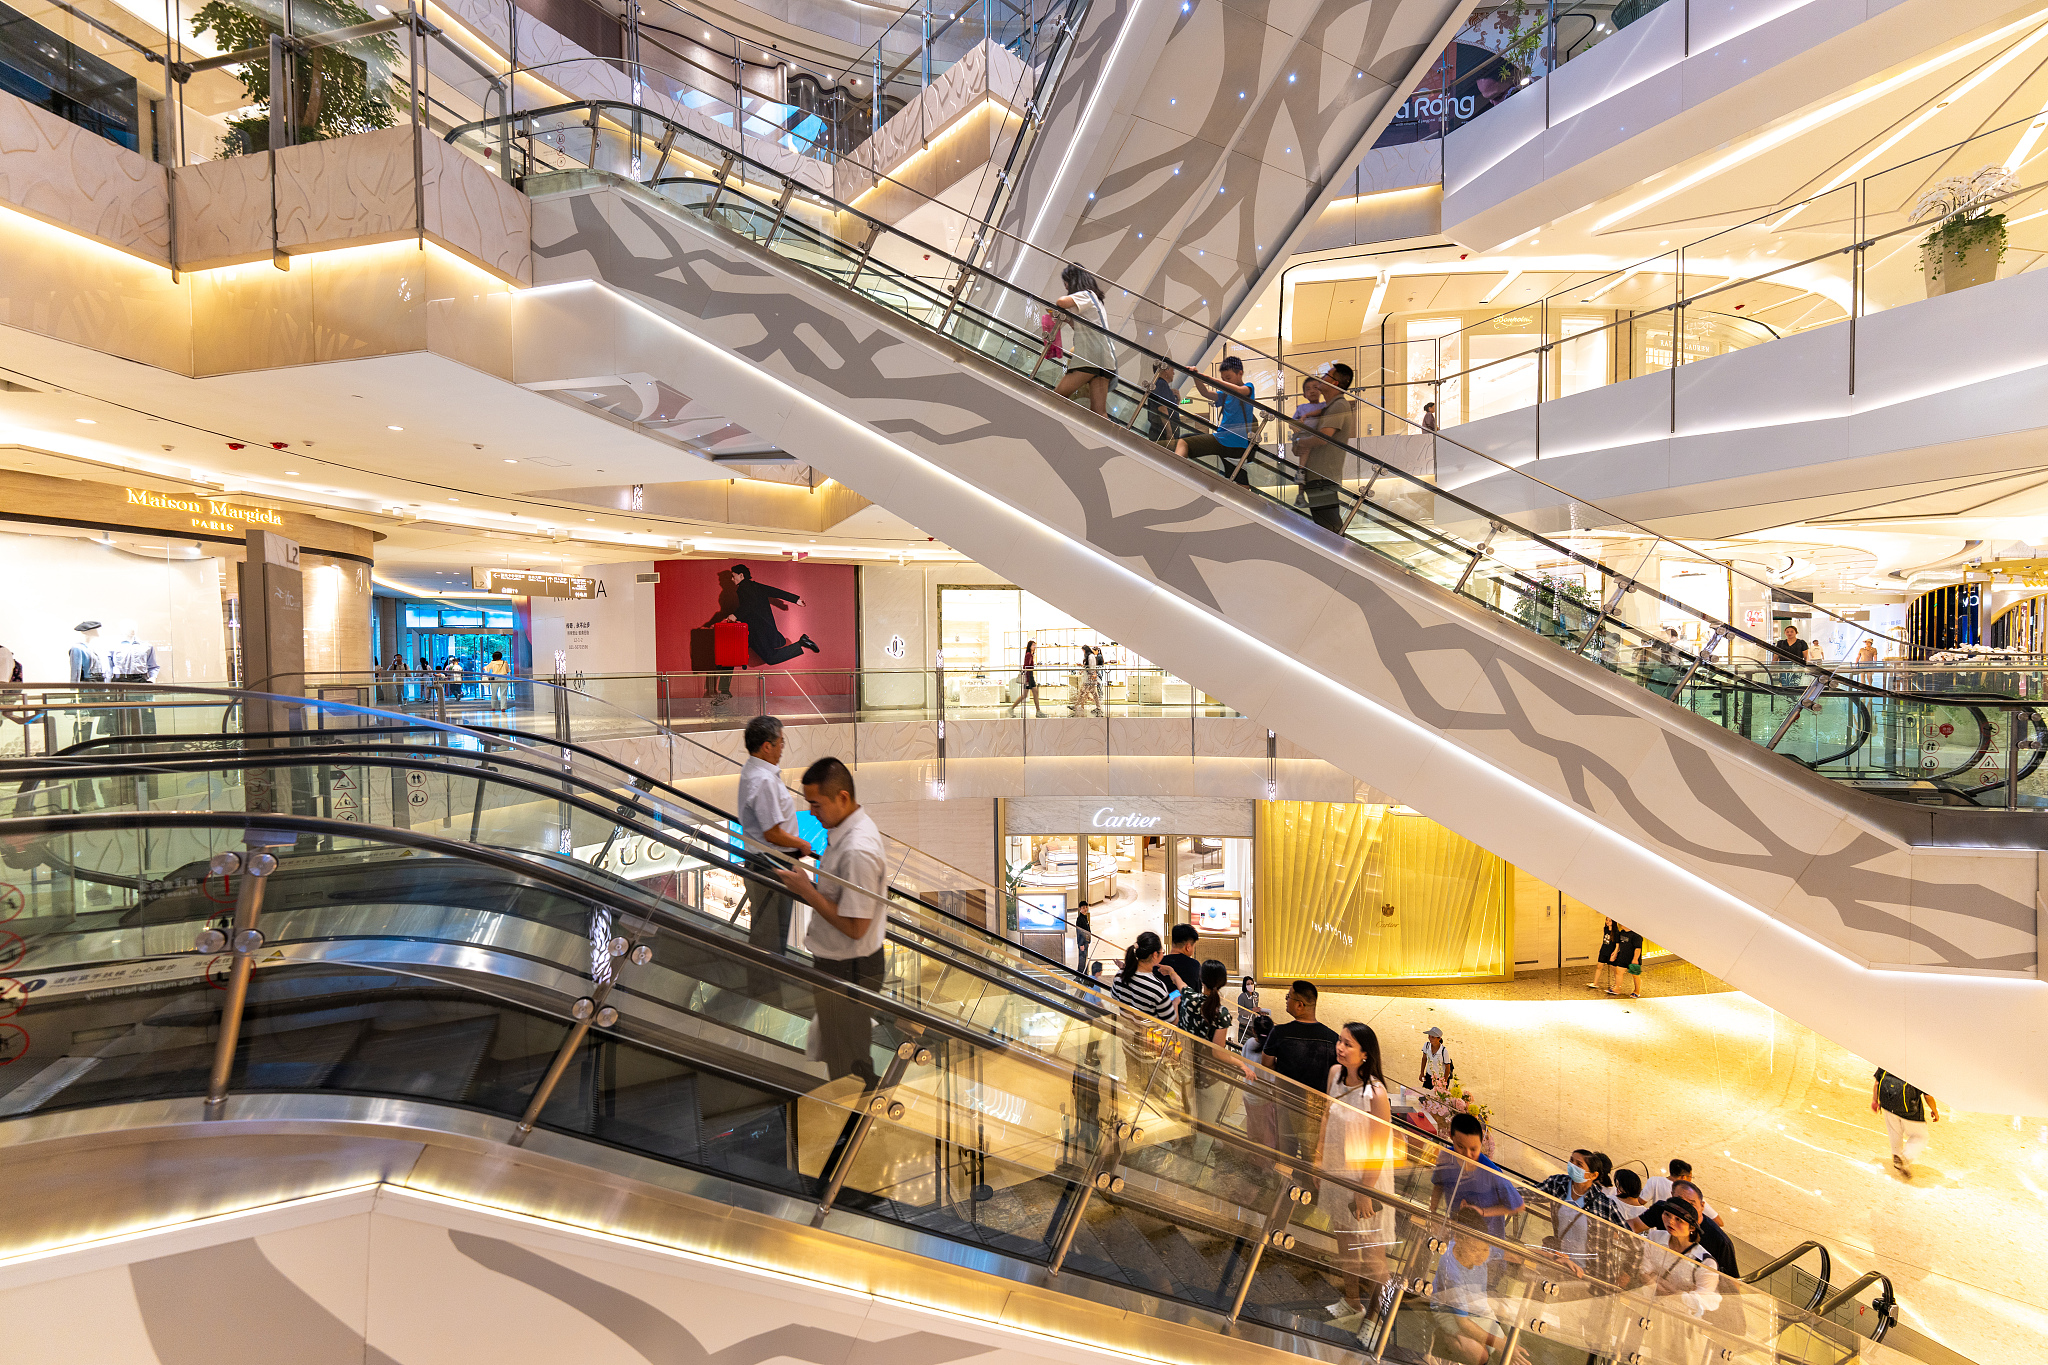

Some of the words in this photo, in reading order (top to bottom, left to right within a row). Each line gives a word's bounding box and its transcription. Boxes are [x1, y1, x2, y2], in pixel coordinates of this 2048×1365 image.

[126, 487, 203, 513] Maison
[209, 500, 284, 526] Margiela
[191, 518, 235, 532] PARIS
[285, 543, 299, 565] L2
[1092, 807, 1161, 828] Cartier
[1375, 920, 1400, 928] Cartier
